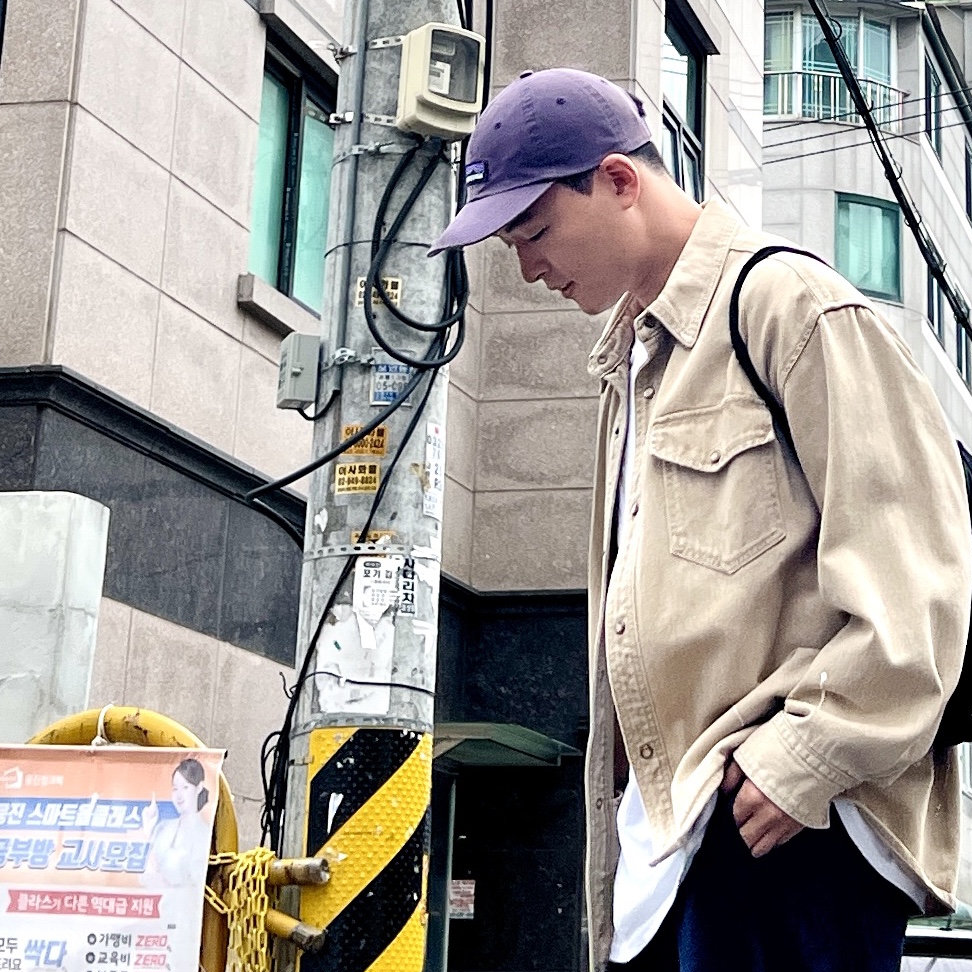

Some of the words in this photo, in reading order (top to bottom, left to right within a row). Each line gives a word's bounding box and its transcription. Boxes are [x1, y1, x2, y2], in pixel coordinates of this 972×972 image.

[56, 839, 150, 873] 교사모집
[64, 894, 90, 913] 다른
[91, 896, 128, 915] 역대급
[131, 898, 154, 916] 지원
[99, 933, 132, 947] 가맹비
[135, 934, 168, 948] ZERO
[24, 939, 68, 968] 싹다
[97, 951, 131, 966] 교육비
[133, 953, 167, 967] ZERO
